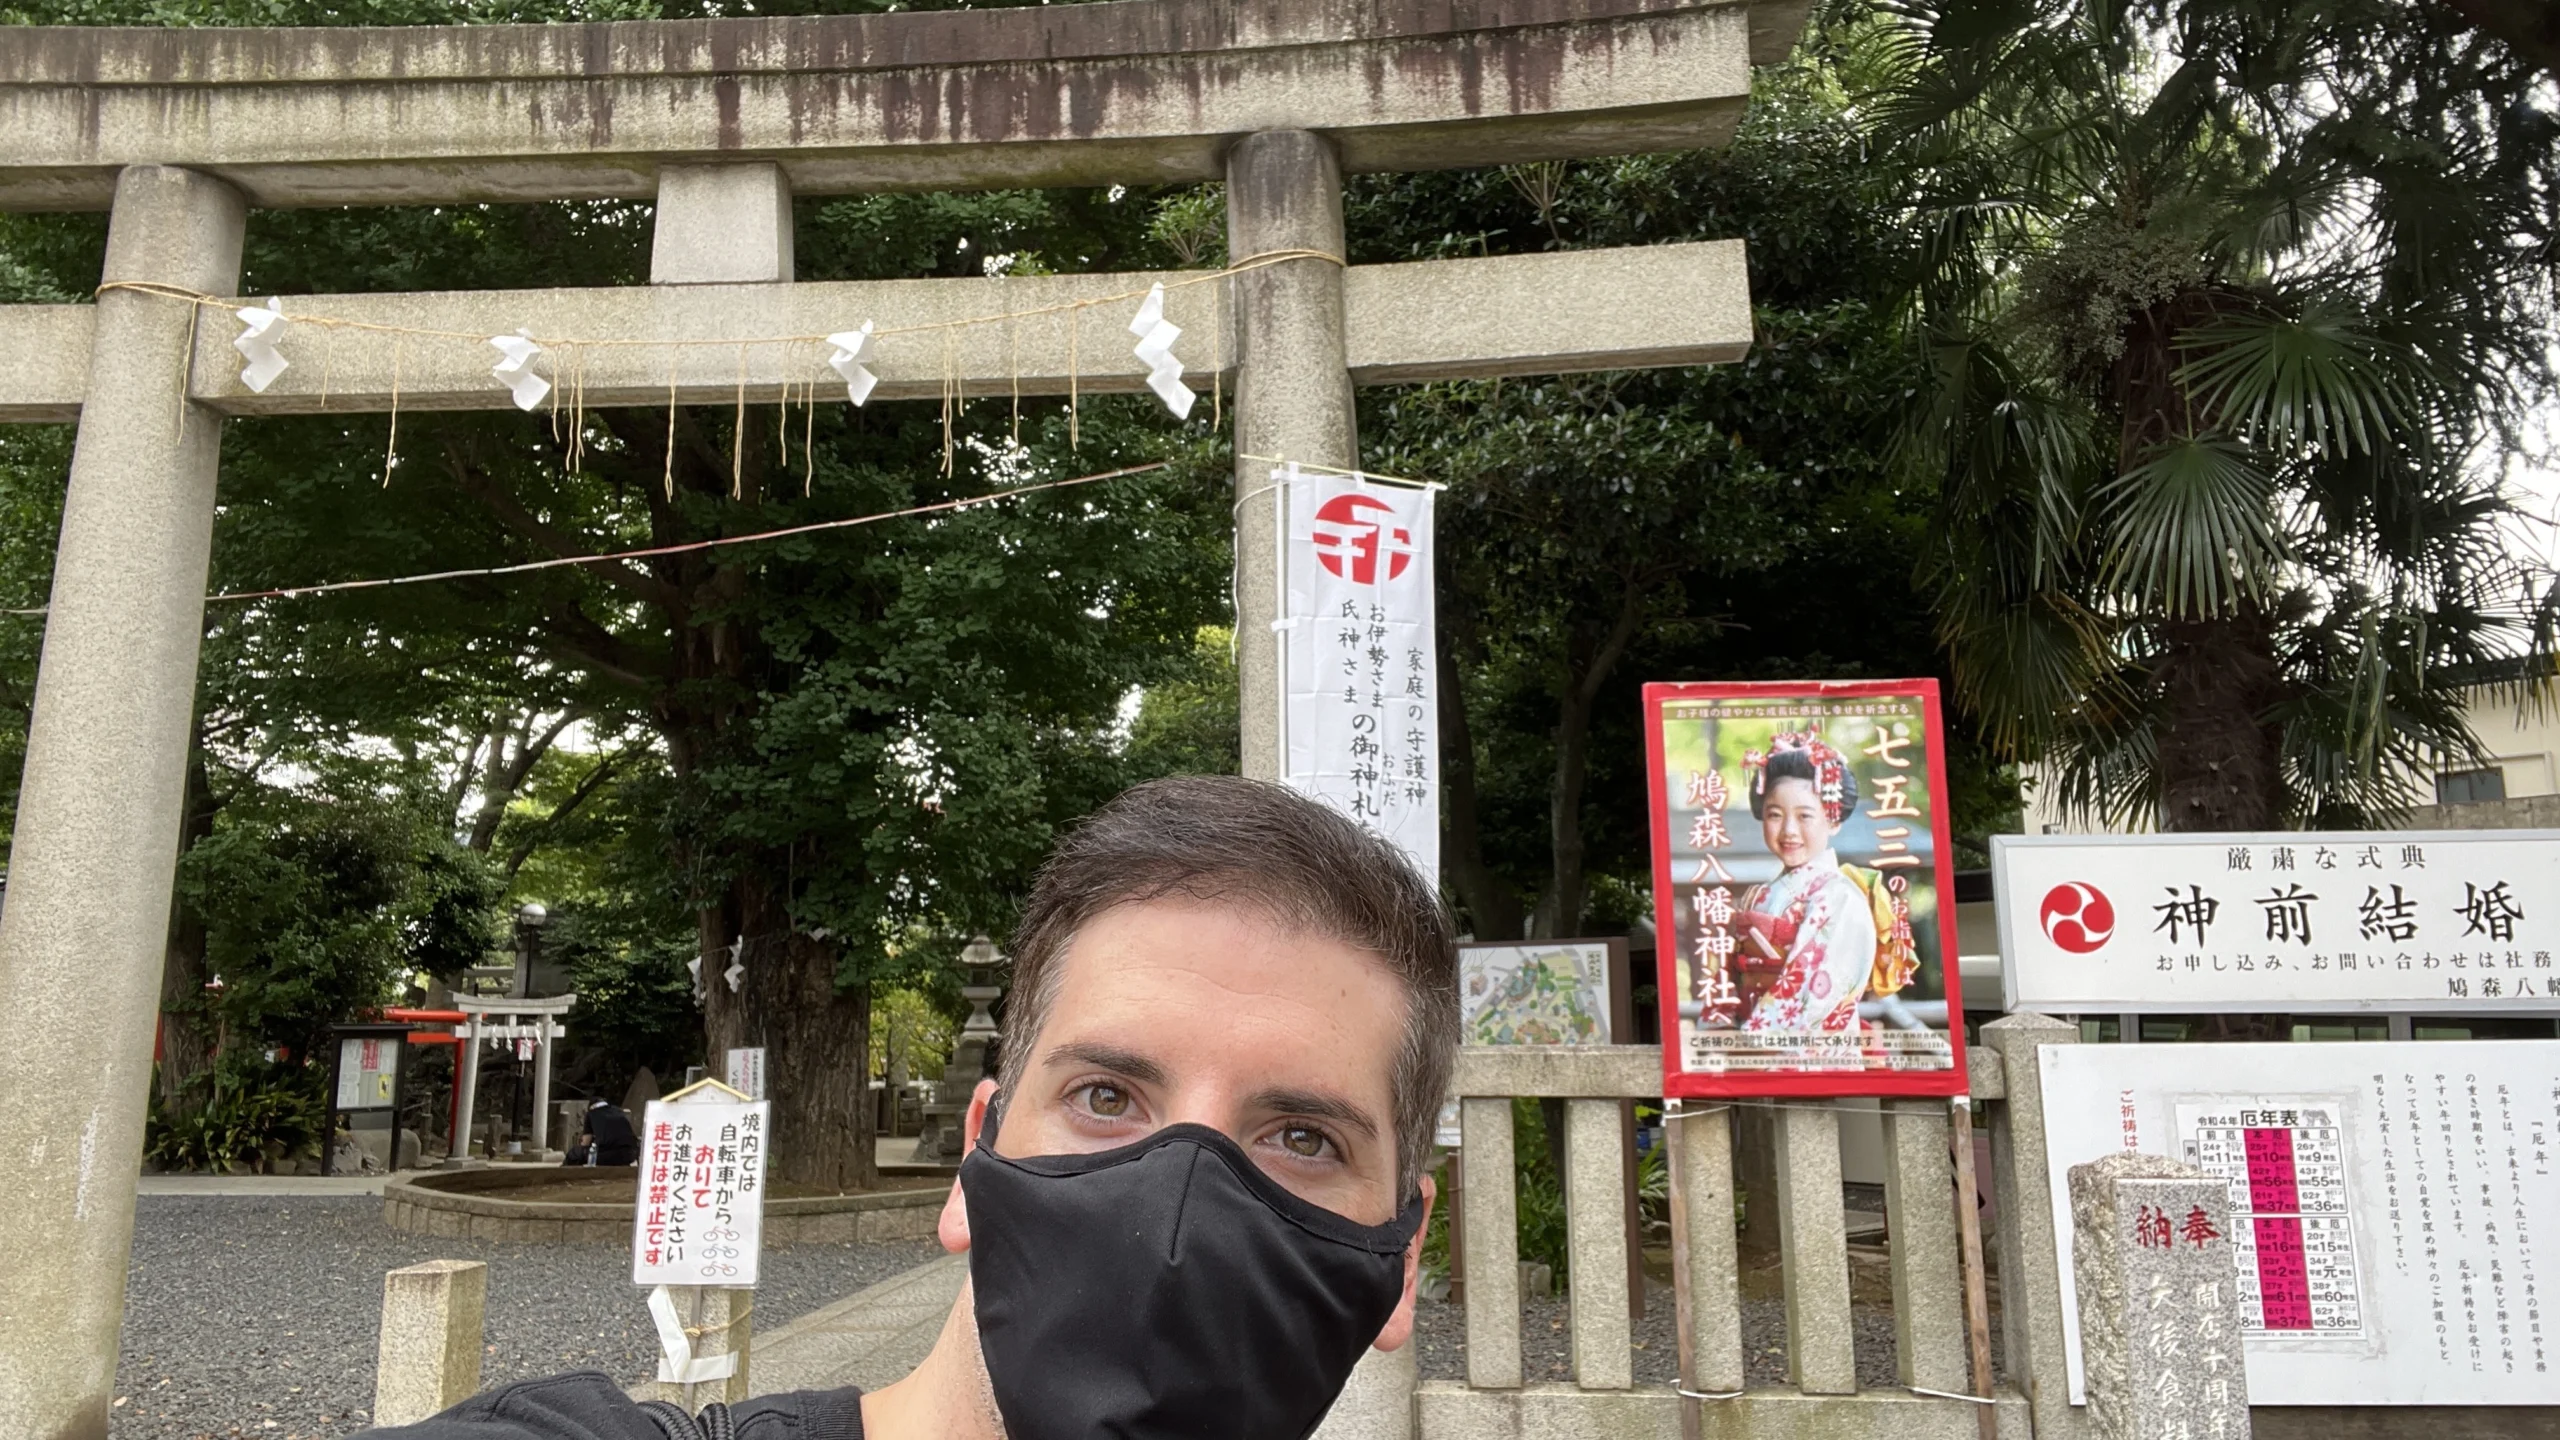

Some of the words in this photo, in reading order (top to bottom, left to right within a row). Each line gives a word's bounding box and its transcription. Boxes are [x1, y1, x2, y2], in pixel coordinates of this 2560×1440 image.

[1338, 599, 1360, 705] 氏神さま
[1367, 603, 1389, 708] お伊勢さま
[1350, 714, 1380, 828] の御神札
[1404, 647, 1427, 806] 家庭の守護神
[1382, 752, 1396, 807] おふだ
[1686, 769, 1741, 1026] 鳩森八幡神社へ
[2228, 845, 2426, 871] 厳粛な式典
[2152, 881, 2526, 949] 神前結婚
[2157, 951, 2552, 972] お申し込み、お問い合わせは社務
[738, 1113, 761, 1192] 境内では
[2198, 1116, 2238, 1126] 令和4年
[2240, 1109, 2300, 1127] 厄年表
[2531, 1121, 2549, 1175] 『厄年』
[645, 1121, 673, 1266] 走行は禁止です
[667, 1123, 693, 1265] お進みください
[692, 1144, 715, 1209] おりて
[715, 1123, 738, 1225] 自転車から
